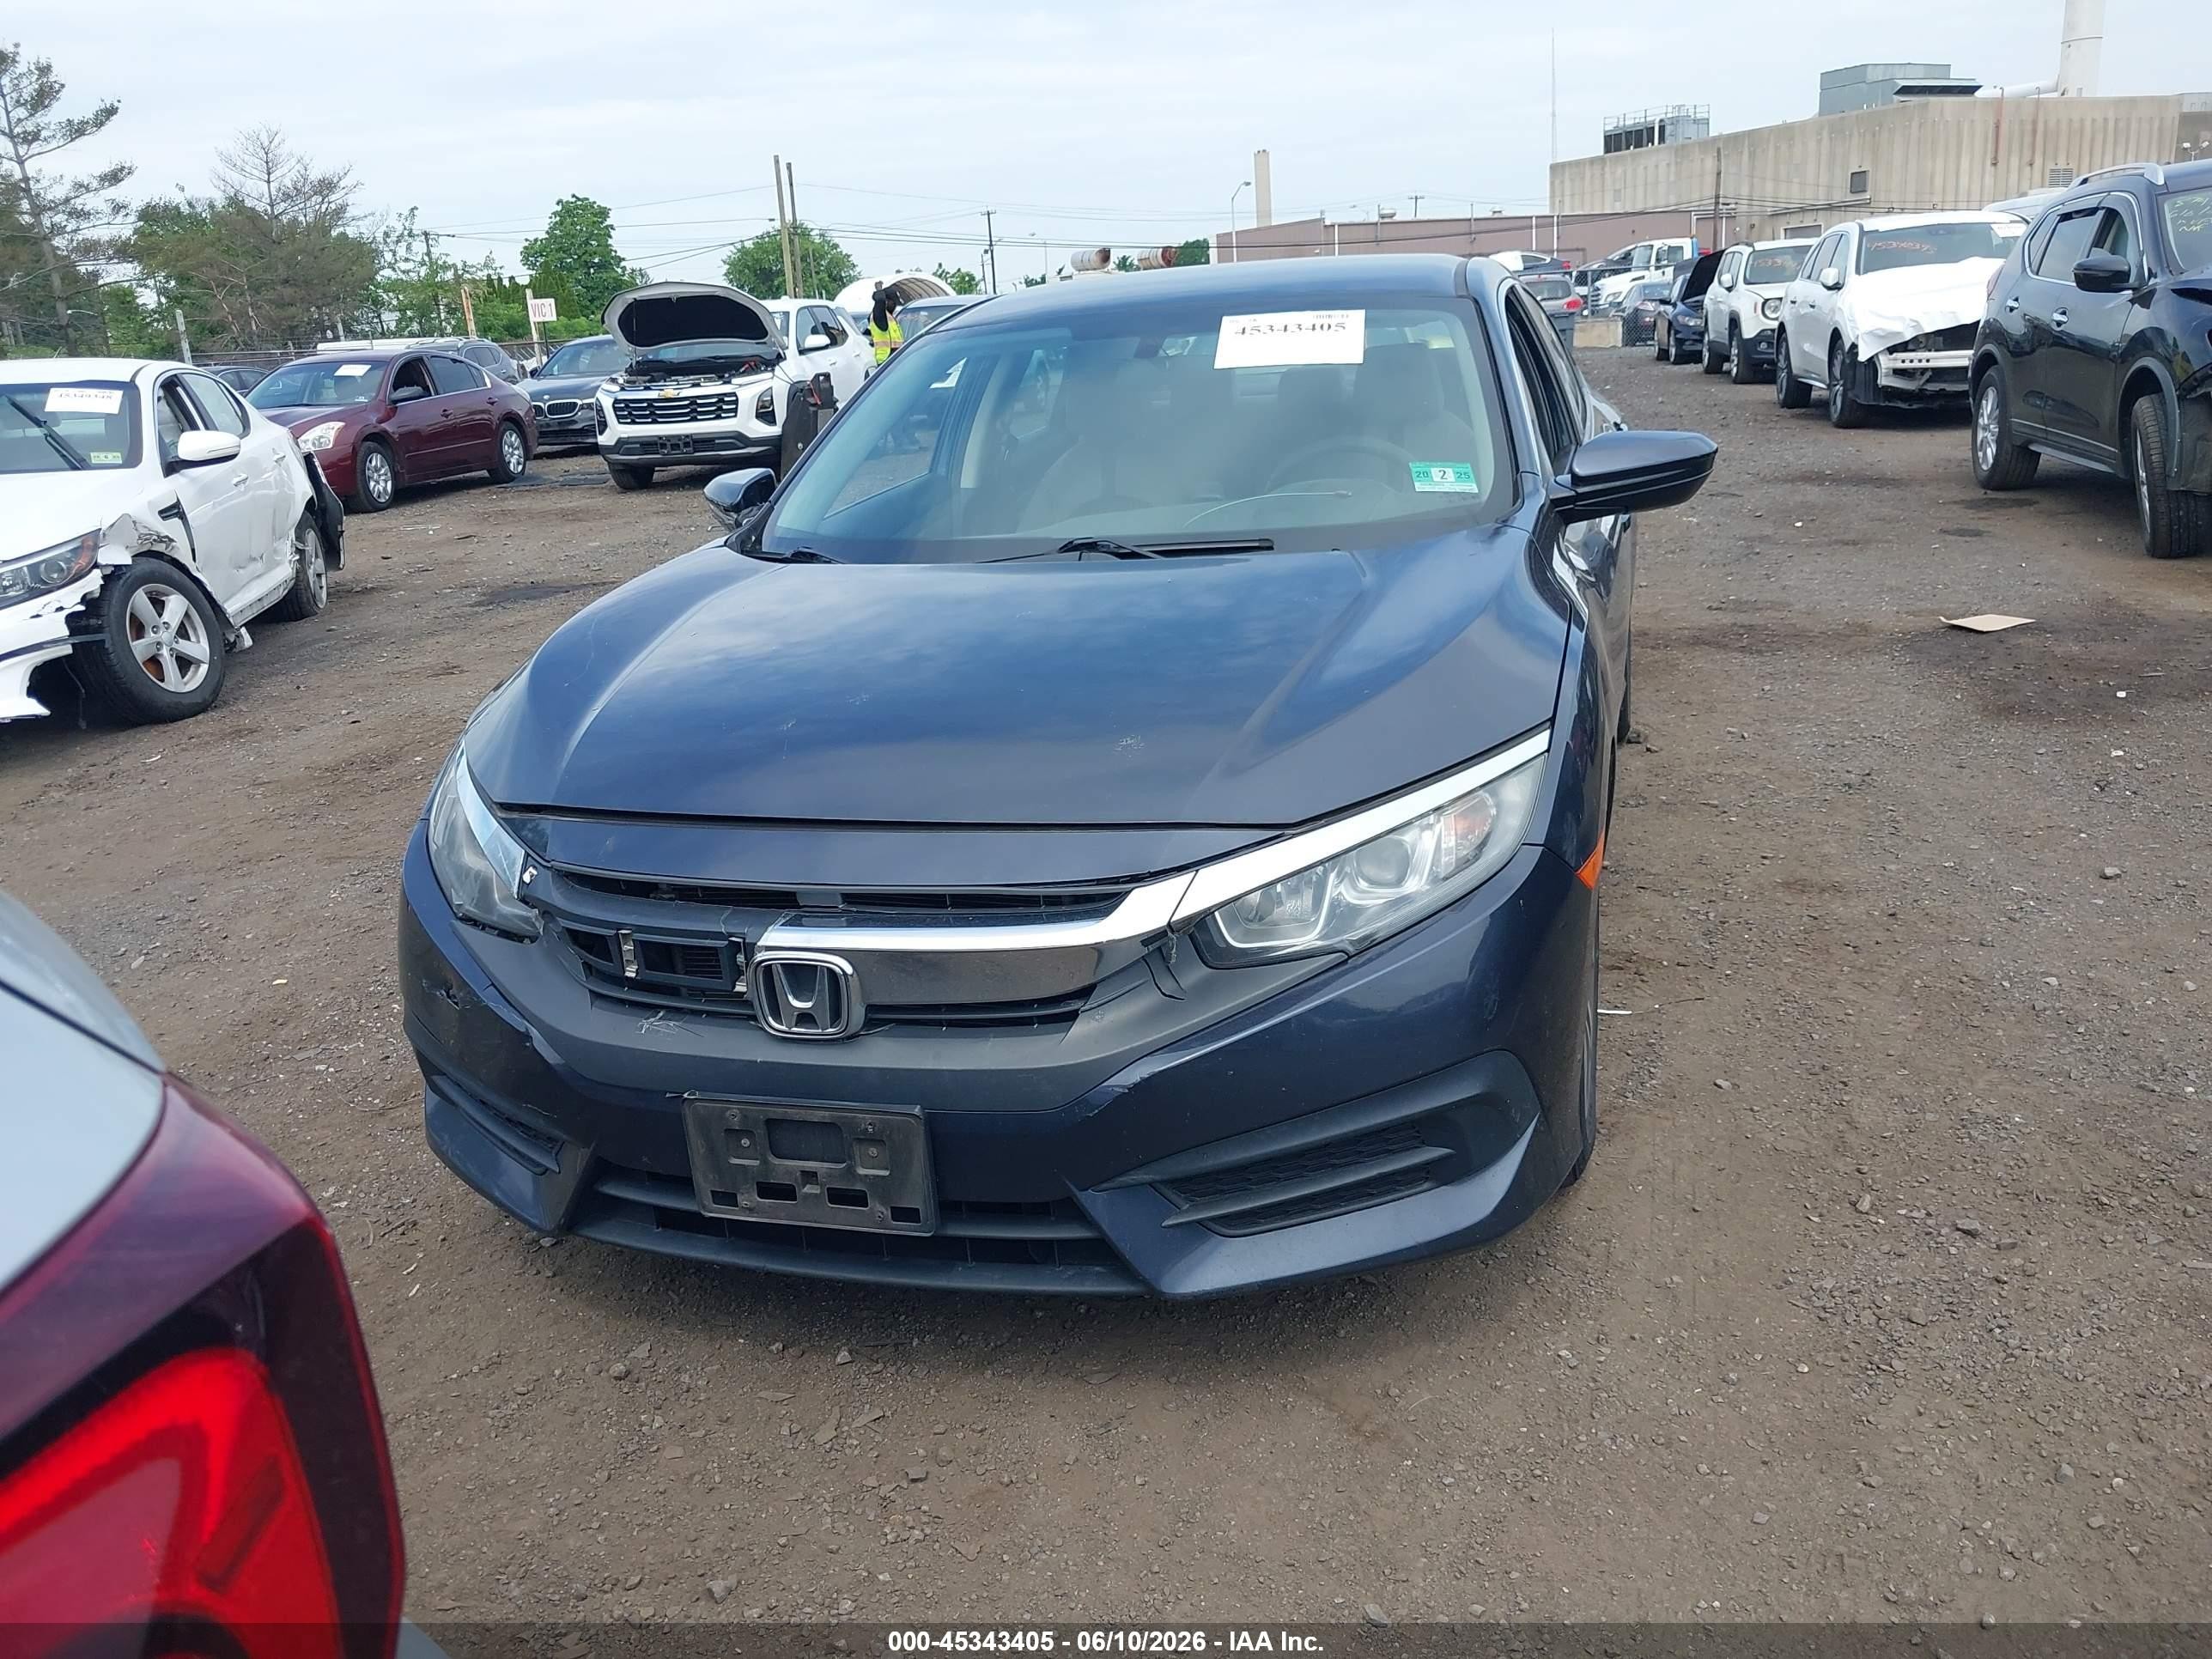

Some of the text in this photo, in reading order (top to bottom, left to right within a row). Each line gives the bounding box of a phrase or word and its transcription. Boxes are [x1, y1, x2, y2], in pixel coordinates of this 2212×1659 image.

[531, 302, 554, 318] VIC 1
[1234, 322, 1346, 336] 45343405
[1437, 469, 1448, 480] 2
